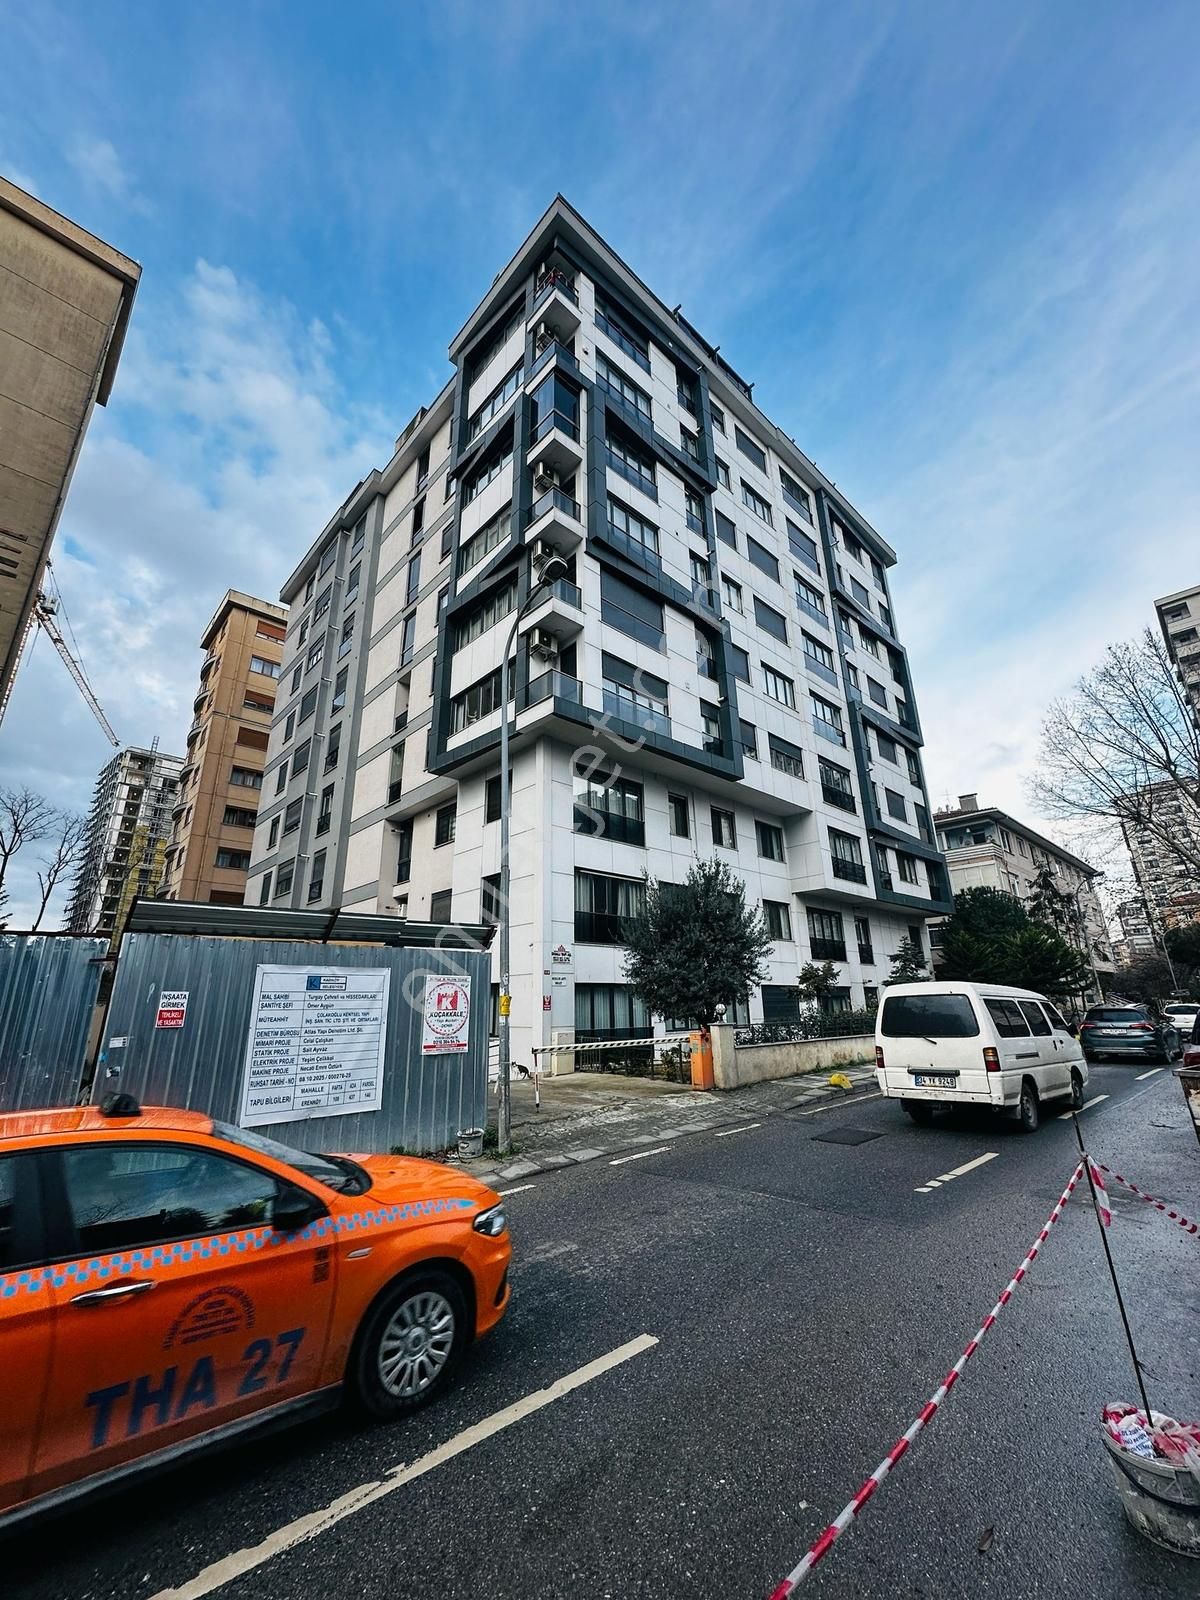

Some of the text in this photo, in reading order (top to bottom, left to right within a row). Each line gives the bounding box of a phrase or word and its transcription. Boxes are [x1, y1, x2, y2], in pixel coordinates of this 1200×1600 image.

[161, 993, 187, 1001] İNŞAATA
[250, 1080, 269, 1088] RUHSAT
[301, 1086, 324, 1094] MAHALLE
[250, 1098, 264, 1107] TAPU
[85, 1326, 306, 1449] THA 27
